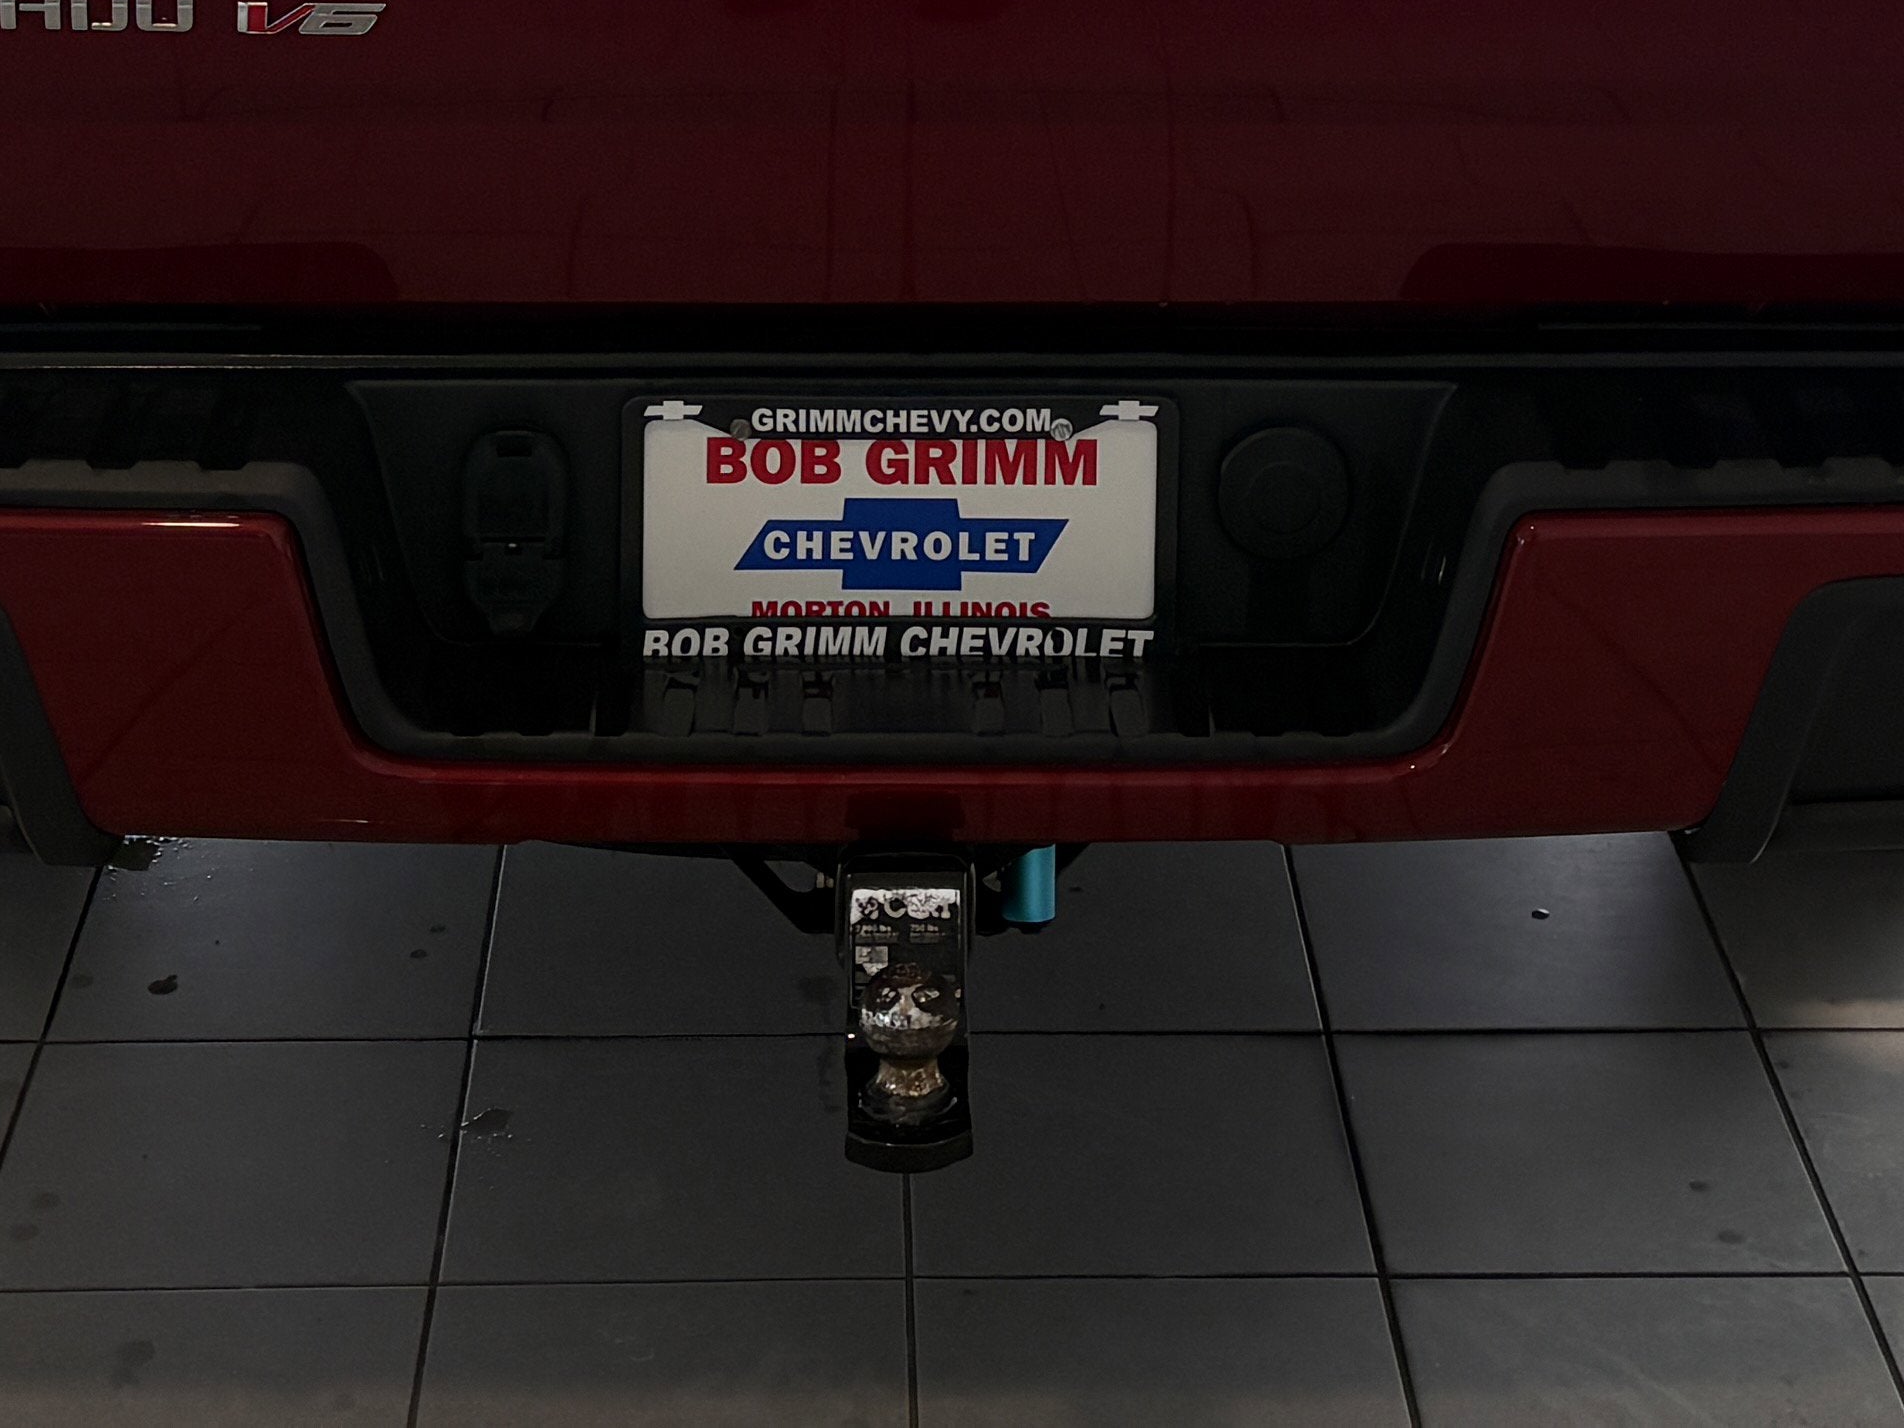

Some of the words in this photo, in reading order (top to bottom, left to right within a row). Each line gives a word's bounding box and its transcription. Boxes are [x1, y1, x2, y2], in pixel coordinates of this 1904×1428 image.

[236, 1, 388, 37] V6
[751, 406, 1053, 435] GRIMMCHEVY.COM
[706, 437, 842, 485] BOB
[865, 438, 1098, 487] GRIMM
[762, 529, 1037, 562] CHEVROLET
[642, 628, 729, 657] BOB
[742, 626, 887, 658] GRIMM
[900, 626, 1156, 659] CHEVROLET
[883, 890, 952, 919] CT
